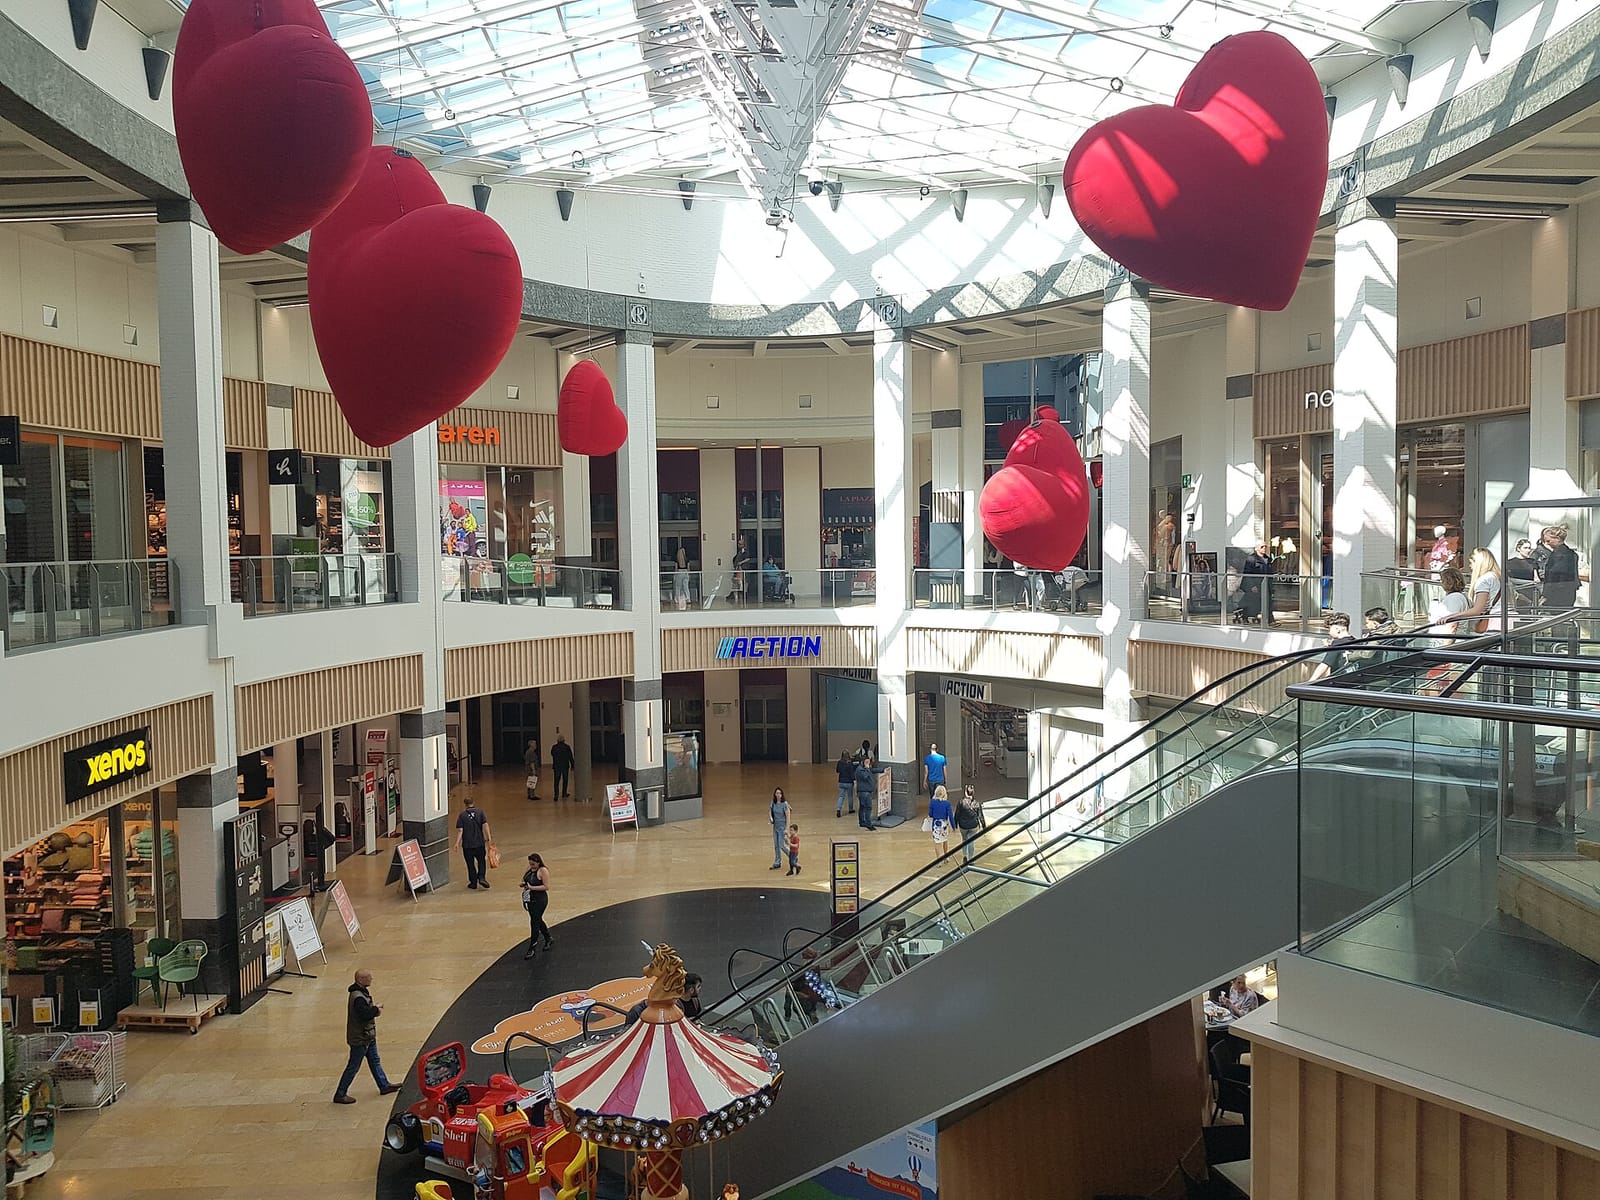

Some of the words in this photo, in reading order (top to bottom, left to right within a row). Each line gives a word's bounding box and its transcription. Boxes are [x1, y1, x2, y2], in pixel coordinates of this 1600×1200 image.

[1305, 389, 1334, 409] no
[730, 635, 822, 658] ACTION
[945, 679, 986, 700] ACTION
[87, 739, 146, 786] xenos
